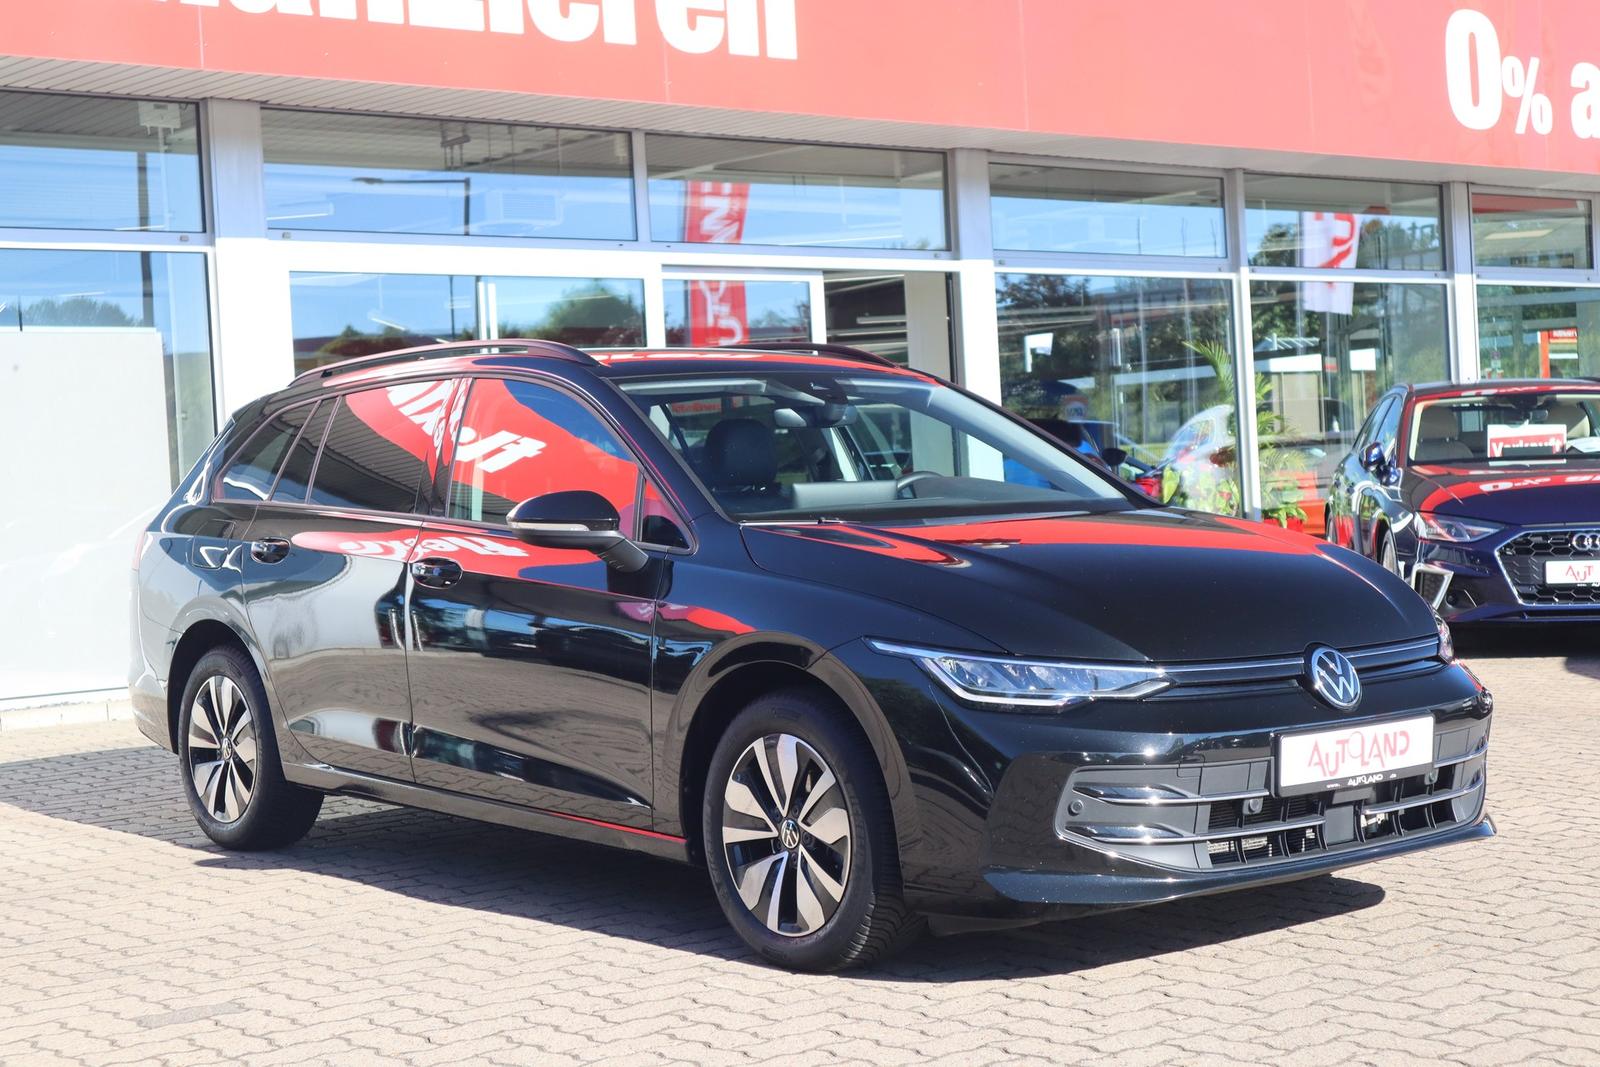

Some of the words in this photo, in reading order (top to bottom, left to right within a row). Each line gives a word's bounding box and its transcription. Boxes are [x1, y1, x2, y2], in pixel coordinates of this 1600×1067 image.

[1445, 9, 1553, 135] 0%
[1314, 650, 1357, 702] VW
[1308, 730, 1410, 777] AUTOLAND
[1347, 773, 1383, 787] AUTOLAND
